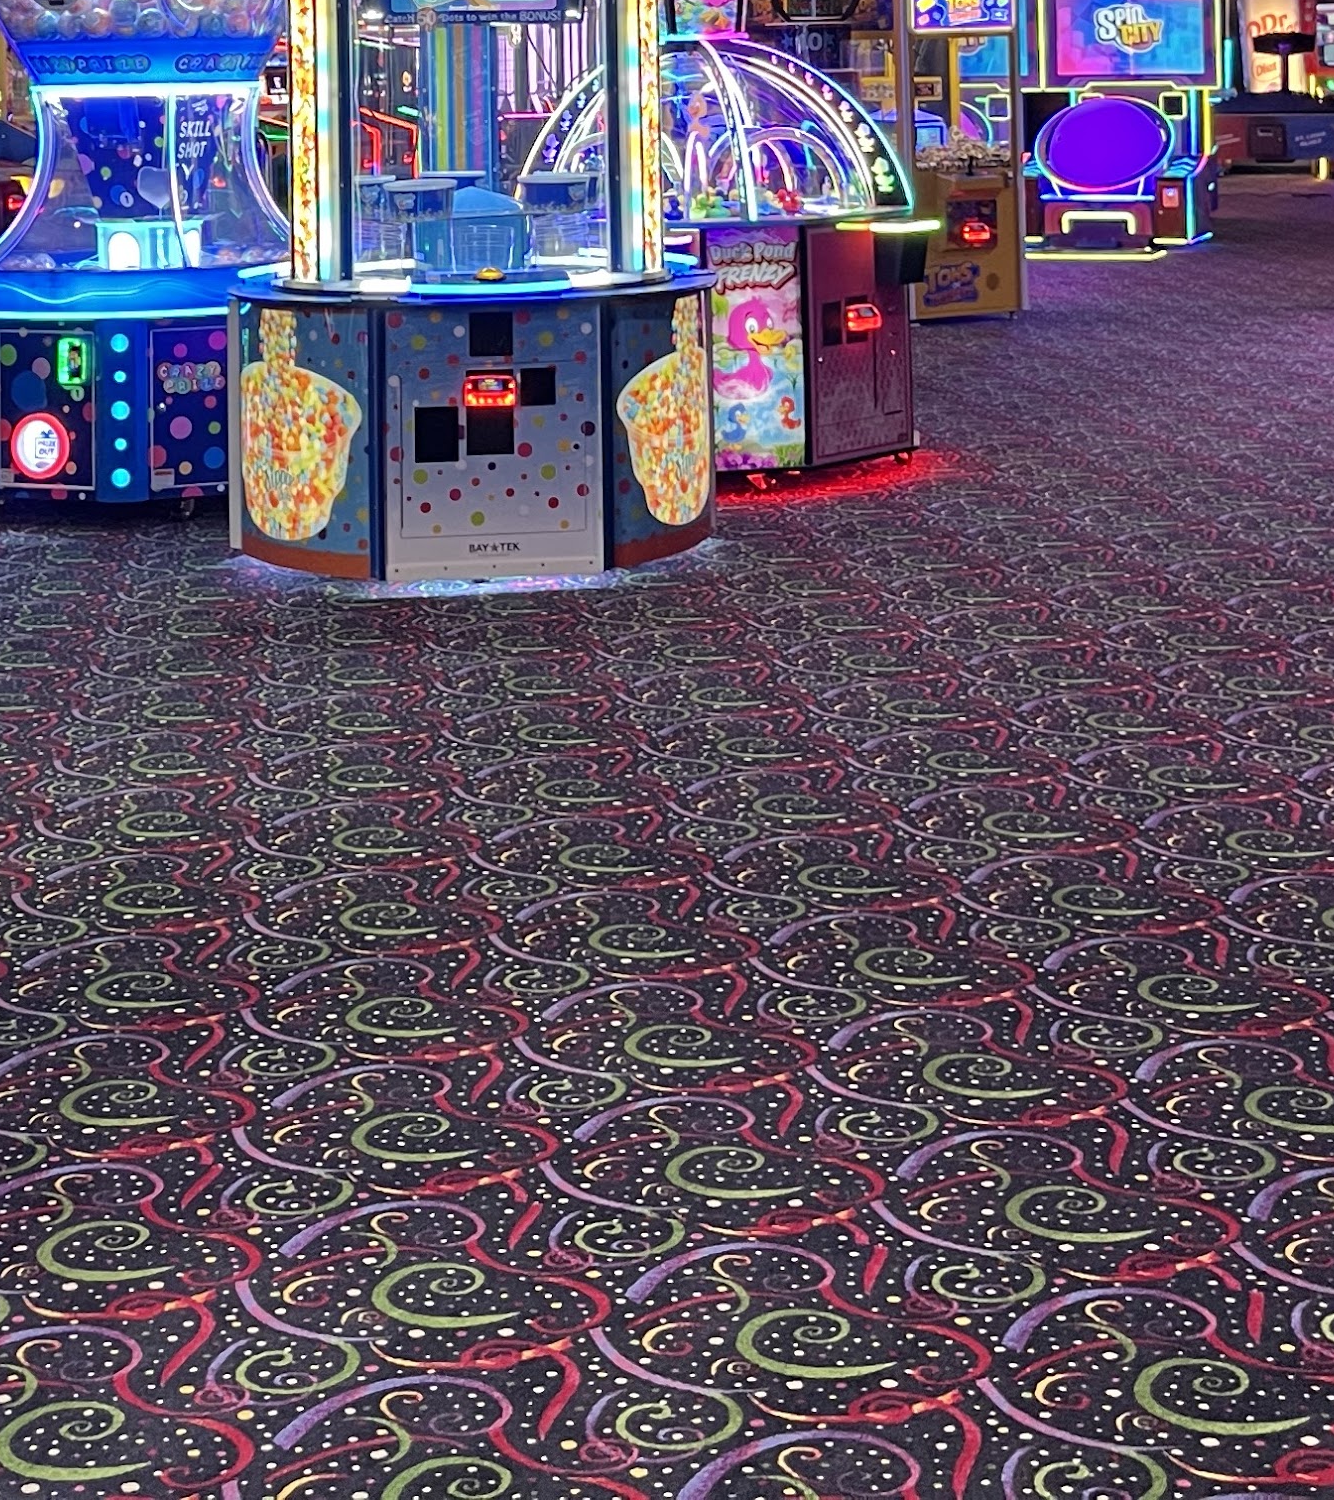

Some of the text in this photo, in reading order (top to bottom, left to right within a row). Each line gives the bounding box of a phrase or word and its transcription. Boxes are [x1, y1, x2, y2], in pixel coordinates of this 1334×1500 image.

[417, 10, 437, 25] 50
[467, 14, 478, 22] to
[479, 14, 495, 22] win
[498, 13, 517, 22] the
[518, 10, 562, 23] BONUS!
[1098, 6, 1145, 41] SPIN
[1118, 21, 1162, 46] CITY
[76, 55, 150, 73] PRIZE
[179, 120, 212, 139] SKILL
[177, 141, 208, 160] SHOT
[711, 240, 798, 265] Duck Pond
[715, 261, 796, 295] FRENZY
[159, 362, 220, 380] CRAZY
[165, 375, 224, 393] PRIZE
[468, 541, 521, 553] BAY TEK
